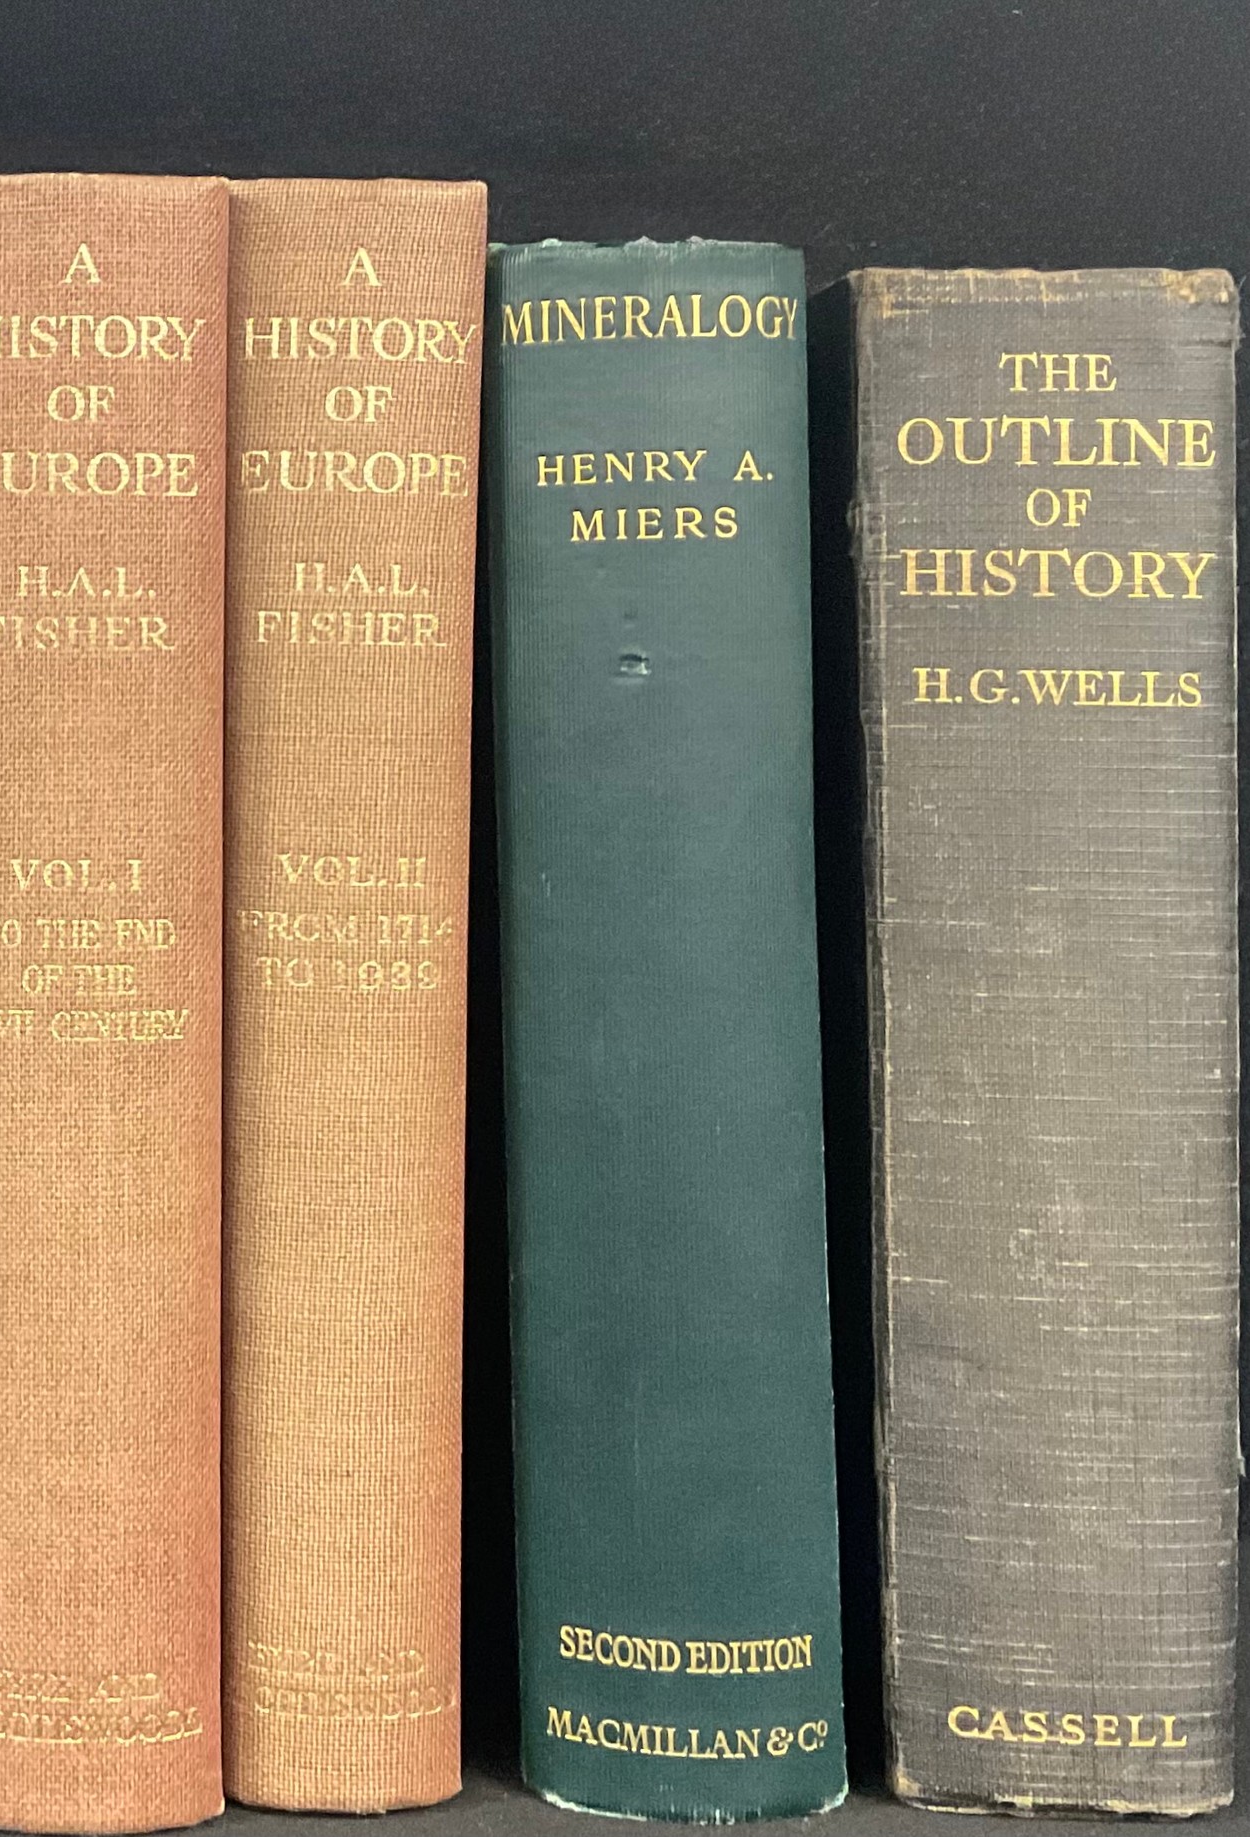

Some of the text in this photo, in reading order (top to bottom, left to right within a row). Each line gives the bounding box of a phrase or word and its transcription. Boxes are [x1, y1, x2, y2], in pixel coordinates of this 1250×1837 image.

[63, 243, 101, 284] A
[341, 247, 381, 287] A
[502, 294, 798, 346] MINERALOGY
[244, 317, 477, 364] HISTORY
[999, 353, 1118, 393] THE
[47, 384, 115, 422] OF
[325, 386, 397, 423] OF
[897, 417, 1217, 468] OUTLINE
[240, 450, 469, 497] EUROPE
[536, 450, 775, 487] HENRY A.
[569, 507, 739, 543] MIERS
[1025, 489, 1092, 527] OF
[17, 565, 157, 598] H.A.L.
[294, 562, 430, 596] H.A.L.
[899, 549, 1215, 601] HISTORY
[257, 611, 447, 647] FISHER
[36, 918, 101, 950] THE
[22, 964, 137, 997] OF THE
[255, 956, 316, 988] TO
[559, 1625, 813, 1675] SECOND EDITION
[546, 1705, 759, 1760] MACMILLAN
[947, 1706, 1188, 1748] CASSELL
